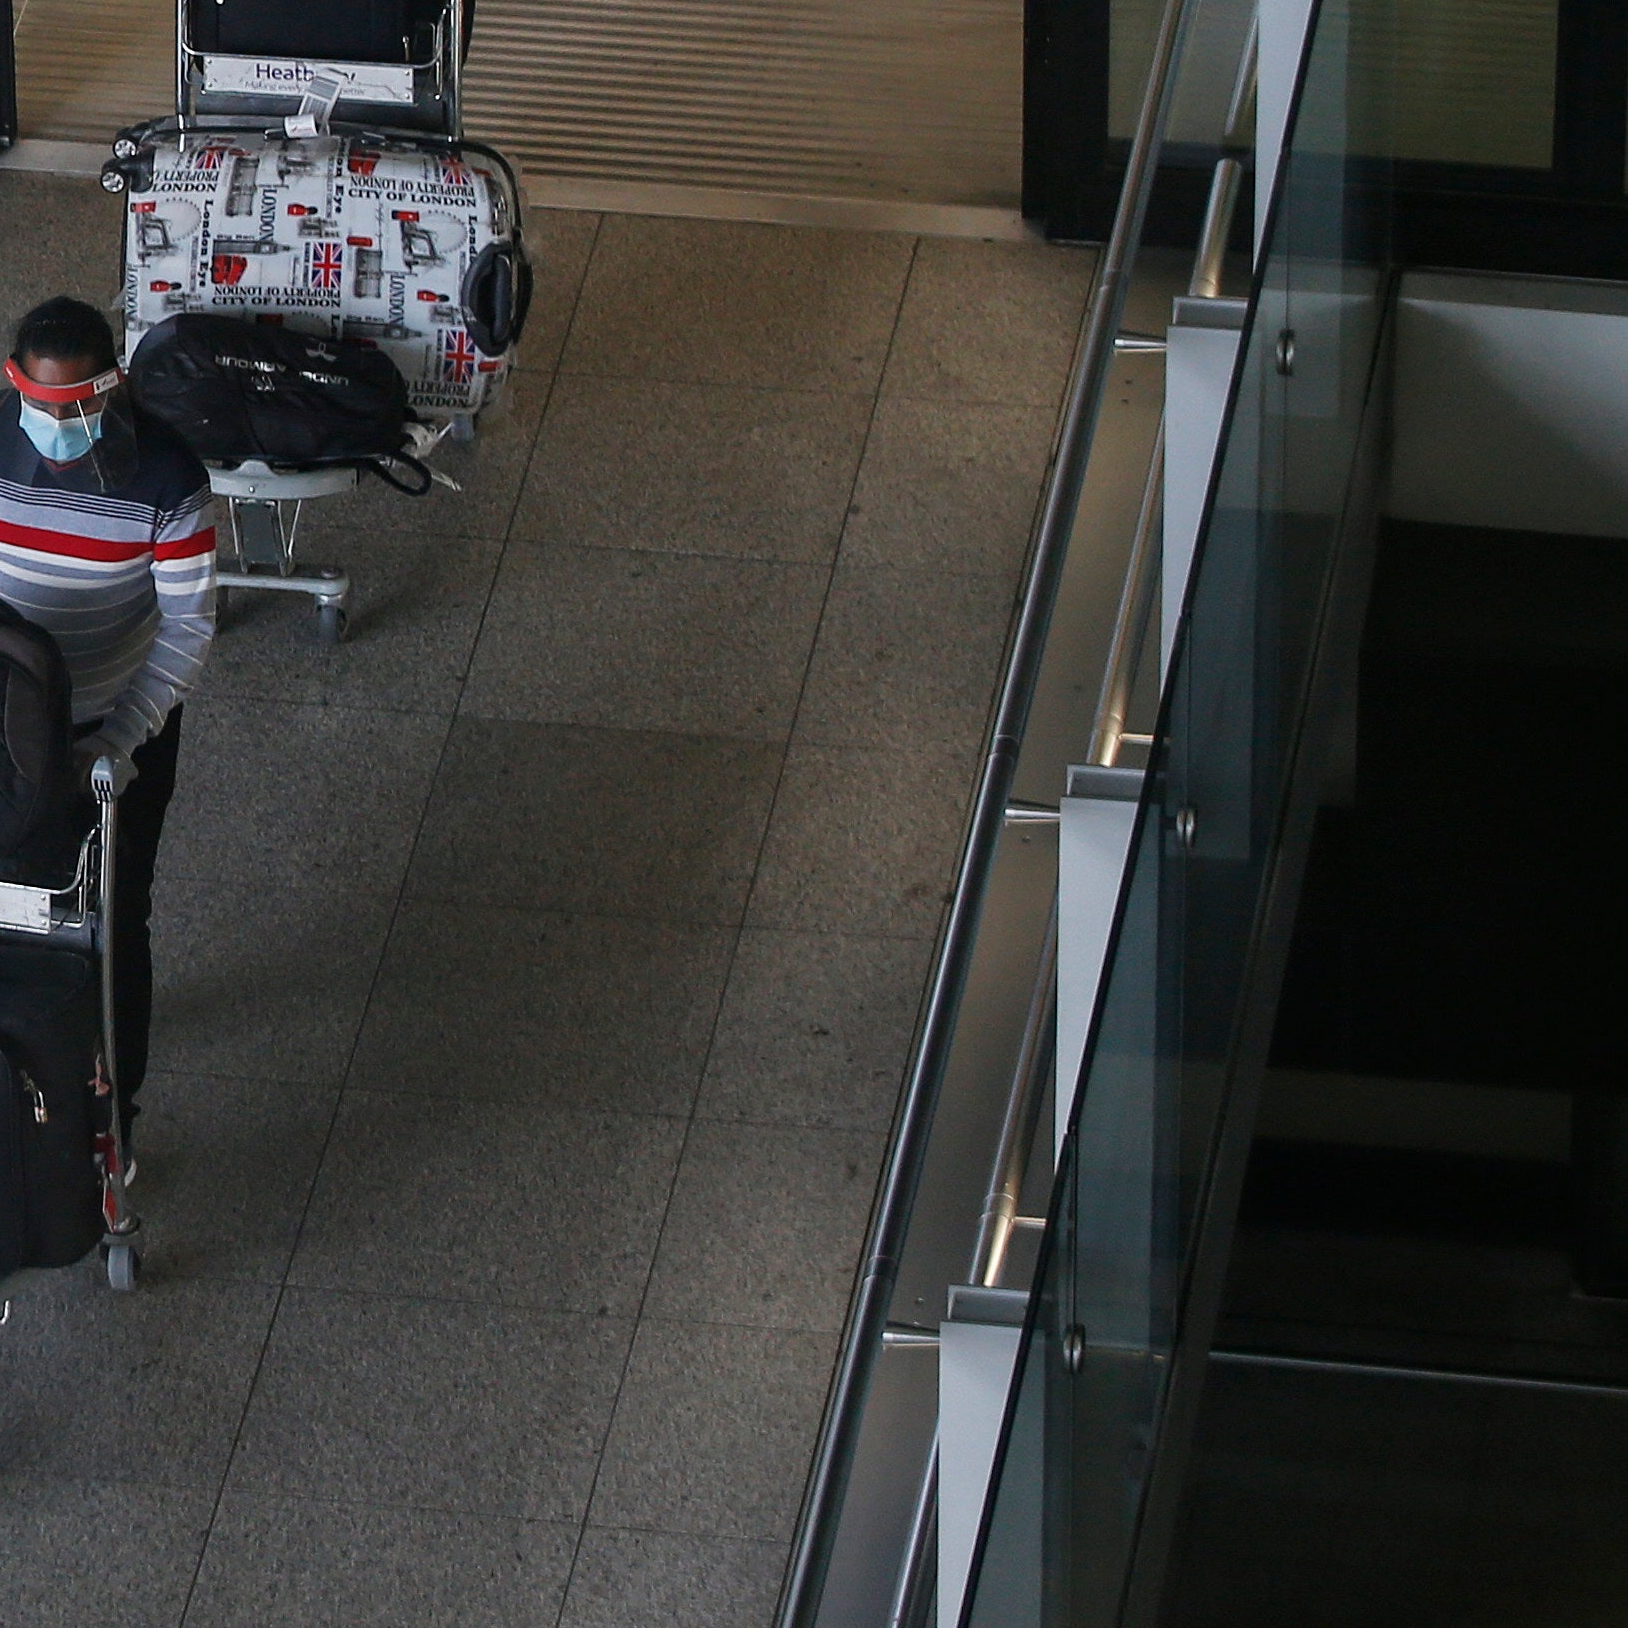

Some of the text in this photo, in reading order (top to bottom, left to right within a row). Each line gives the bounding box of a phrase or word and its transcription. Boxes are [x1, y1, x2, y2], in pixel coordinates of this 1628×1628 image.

[350, 175, 400, 190] LONDON
[416, 182, 475, 198] PROPERTY
[348, 188, 477, 208] CITY OF LONDON
[259, 187, 278, 242] LONDON
[198, 199, 214, 288] London Eye
[214, 285, 263, 296] LONDON
[283, 286, 341, 299] PROPERTY
[211, 296, 341, 308] CITY OF LONDON
[389, 274, 406, 325] LONDON
